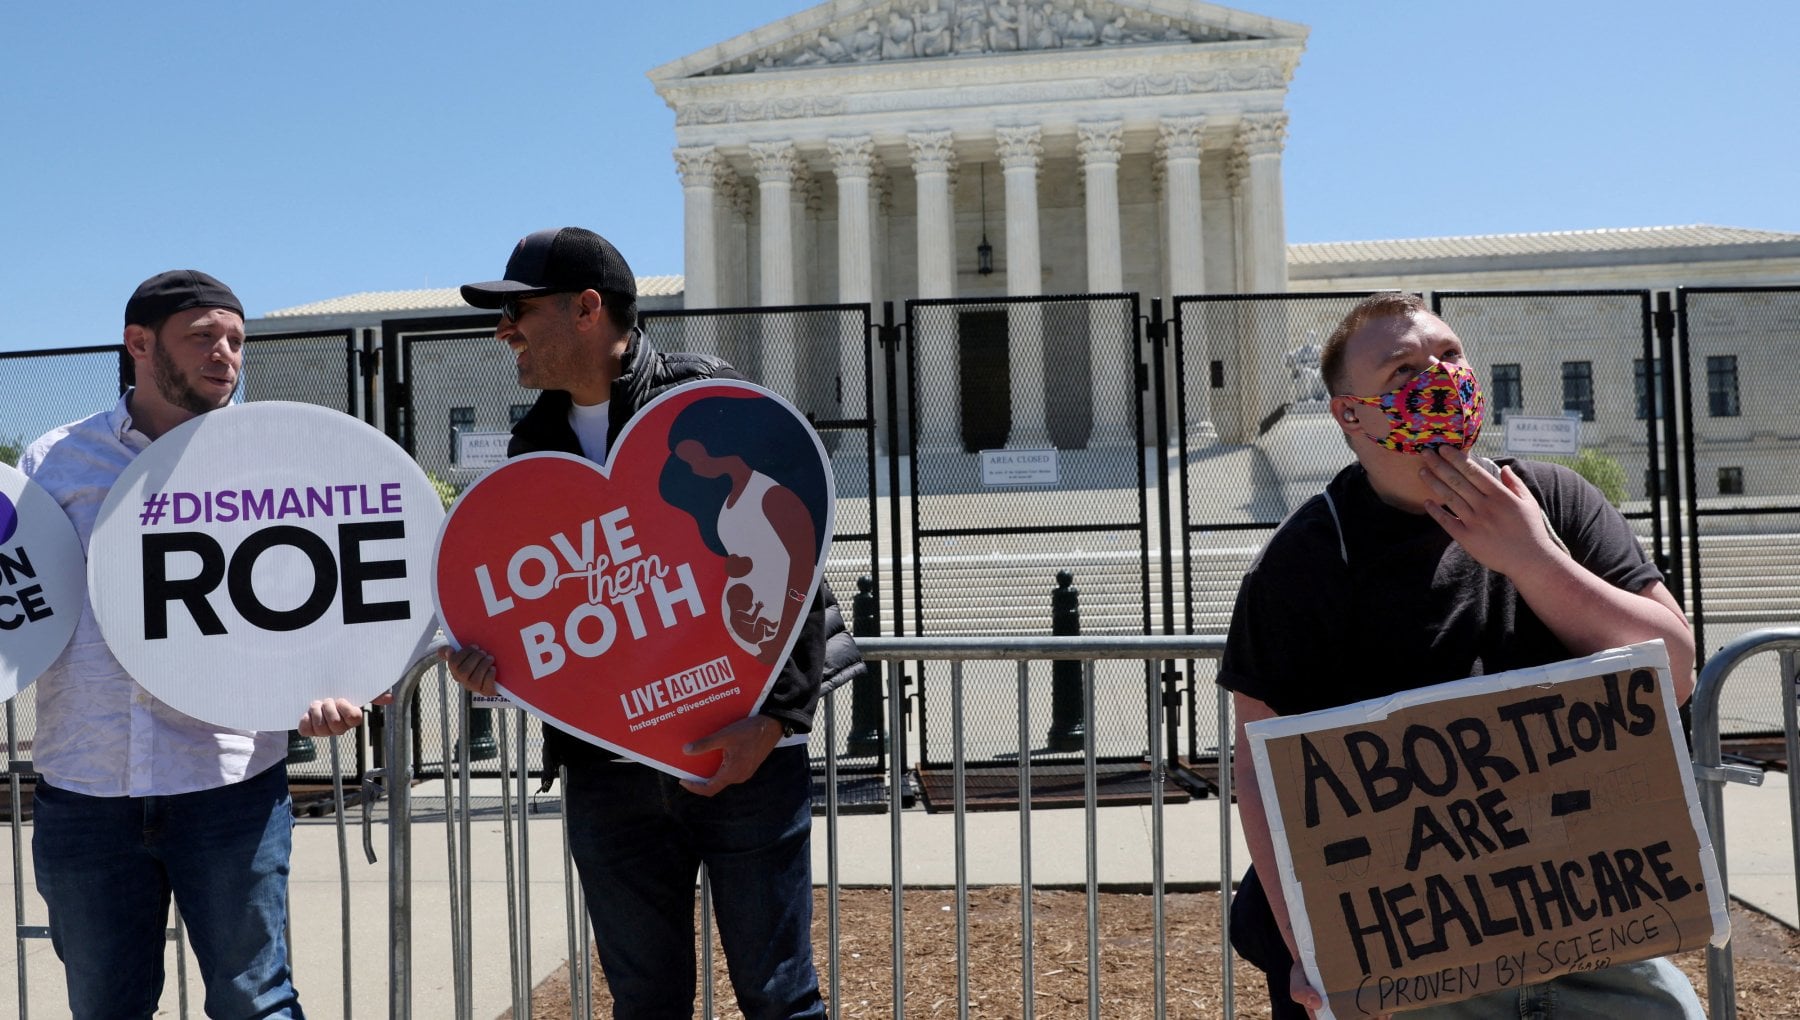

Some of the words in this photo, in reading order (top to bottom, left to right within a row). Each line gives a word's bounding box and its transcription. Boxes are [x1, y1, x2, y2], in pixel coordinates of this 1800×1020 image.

[469, 439, 490, 448] AREA
[990, 455, 1013, 464] AREA
[1016, 454, 1050, 464] CLOSED
[139, 482, 403, 526] #DISMANTLE
[141, 519, 411, 641] ROE
[474, 505, 643, 618] LOVE
[554, 554, 670, 605] them
[519, 562, 706, 681] BOTH
[620, 680, 669, 720] LIVE
[670, 658, 733, 700] ACTION
[629, 711, 676, 733] Instagram:
[677, 686, 741, 714] @liveactionorg
[1300, 668, 1657, 829] ABORTIONS
[1404, 789, 1531, 871] ARE
[1339, 840, 1705, 976] HEALTHCARE.
[1355, 963, 1481, 1016] (PROVEN
[1496, 951, 1526, 988] BY
[1536, 902, 1682, 975] SCIENCE)
